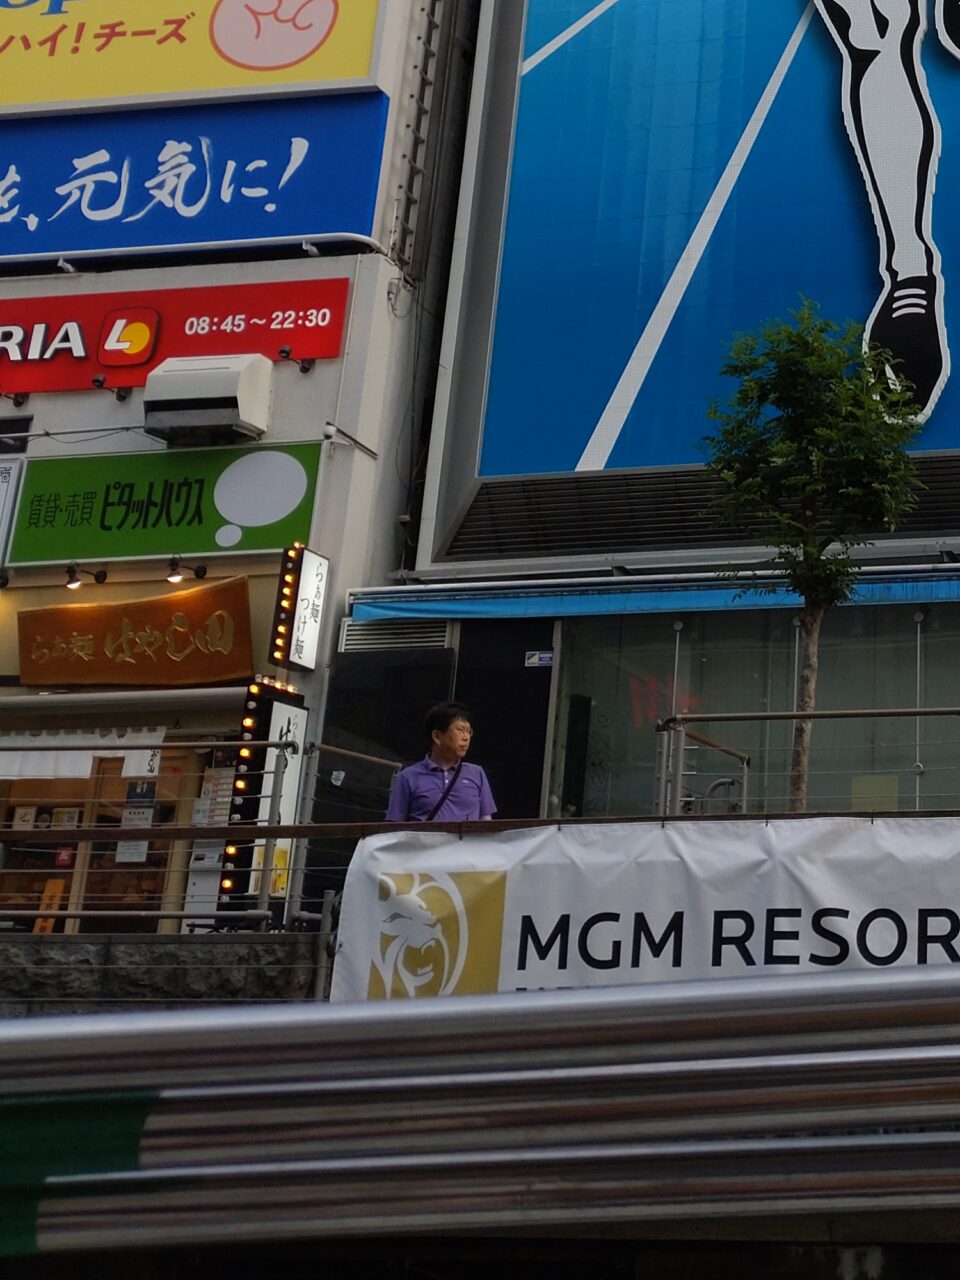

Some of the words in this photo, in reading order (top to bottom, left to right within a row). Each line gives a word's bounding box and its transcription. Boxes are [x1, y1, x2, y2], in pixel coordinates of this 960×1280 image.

[100, 477, 205, 531] ピタットハウス
[517, 911, 684, 970] MGM
